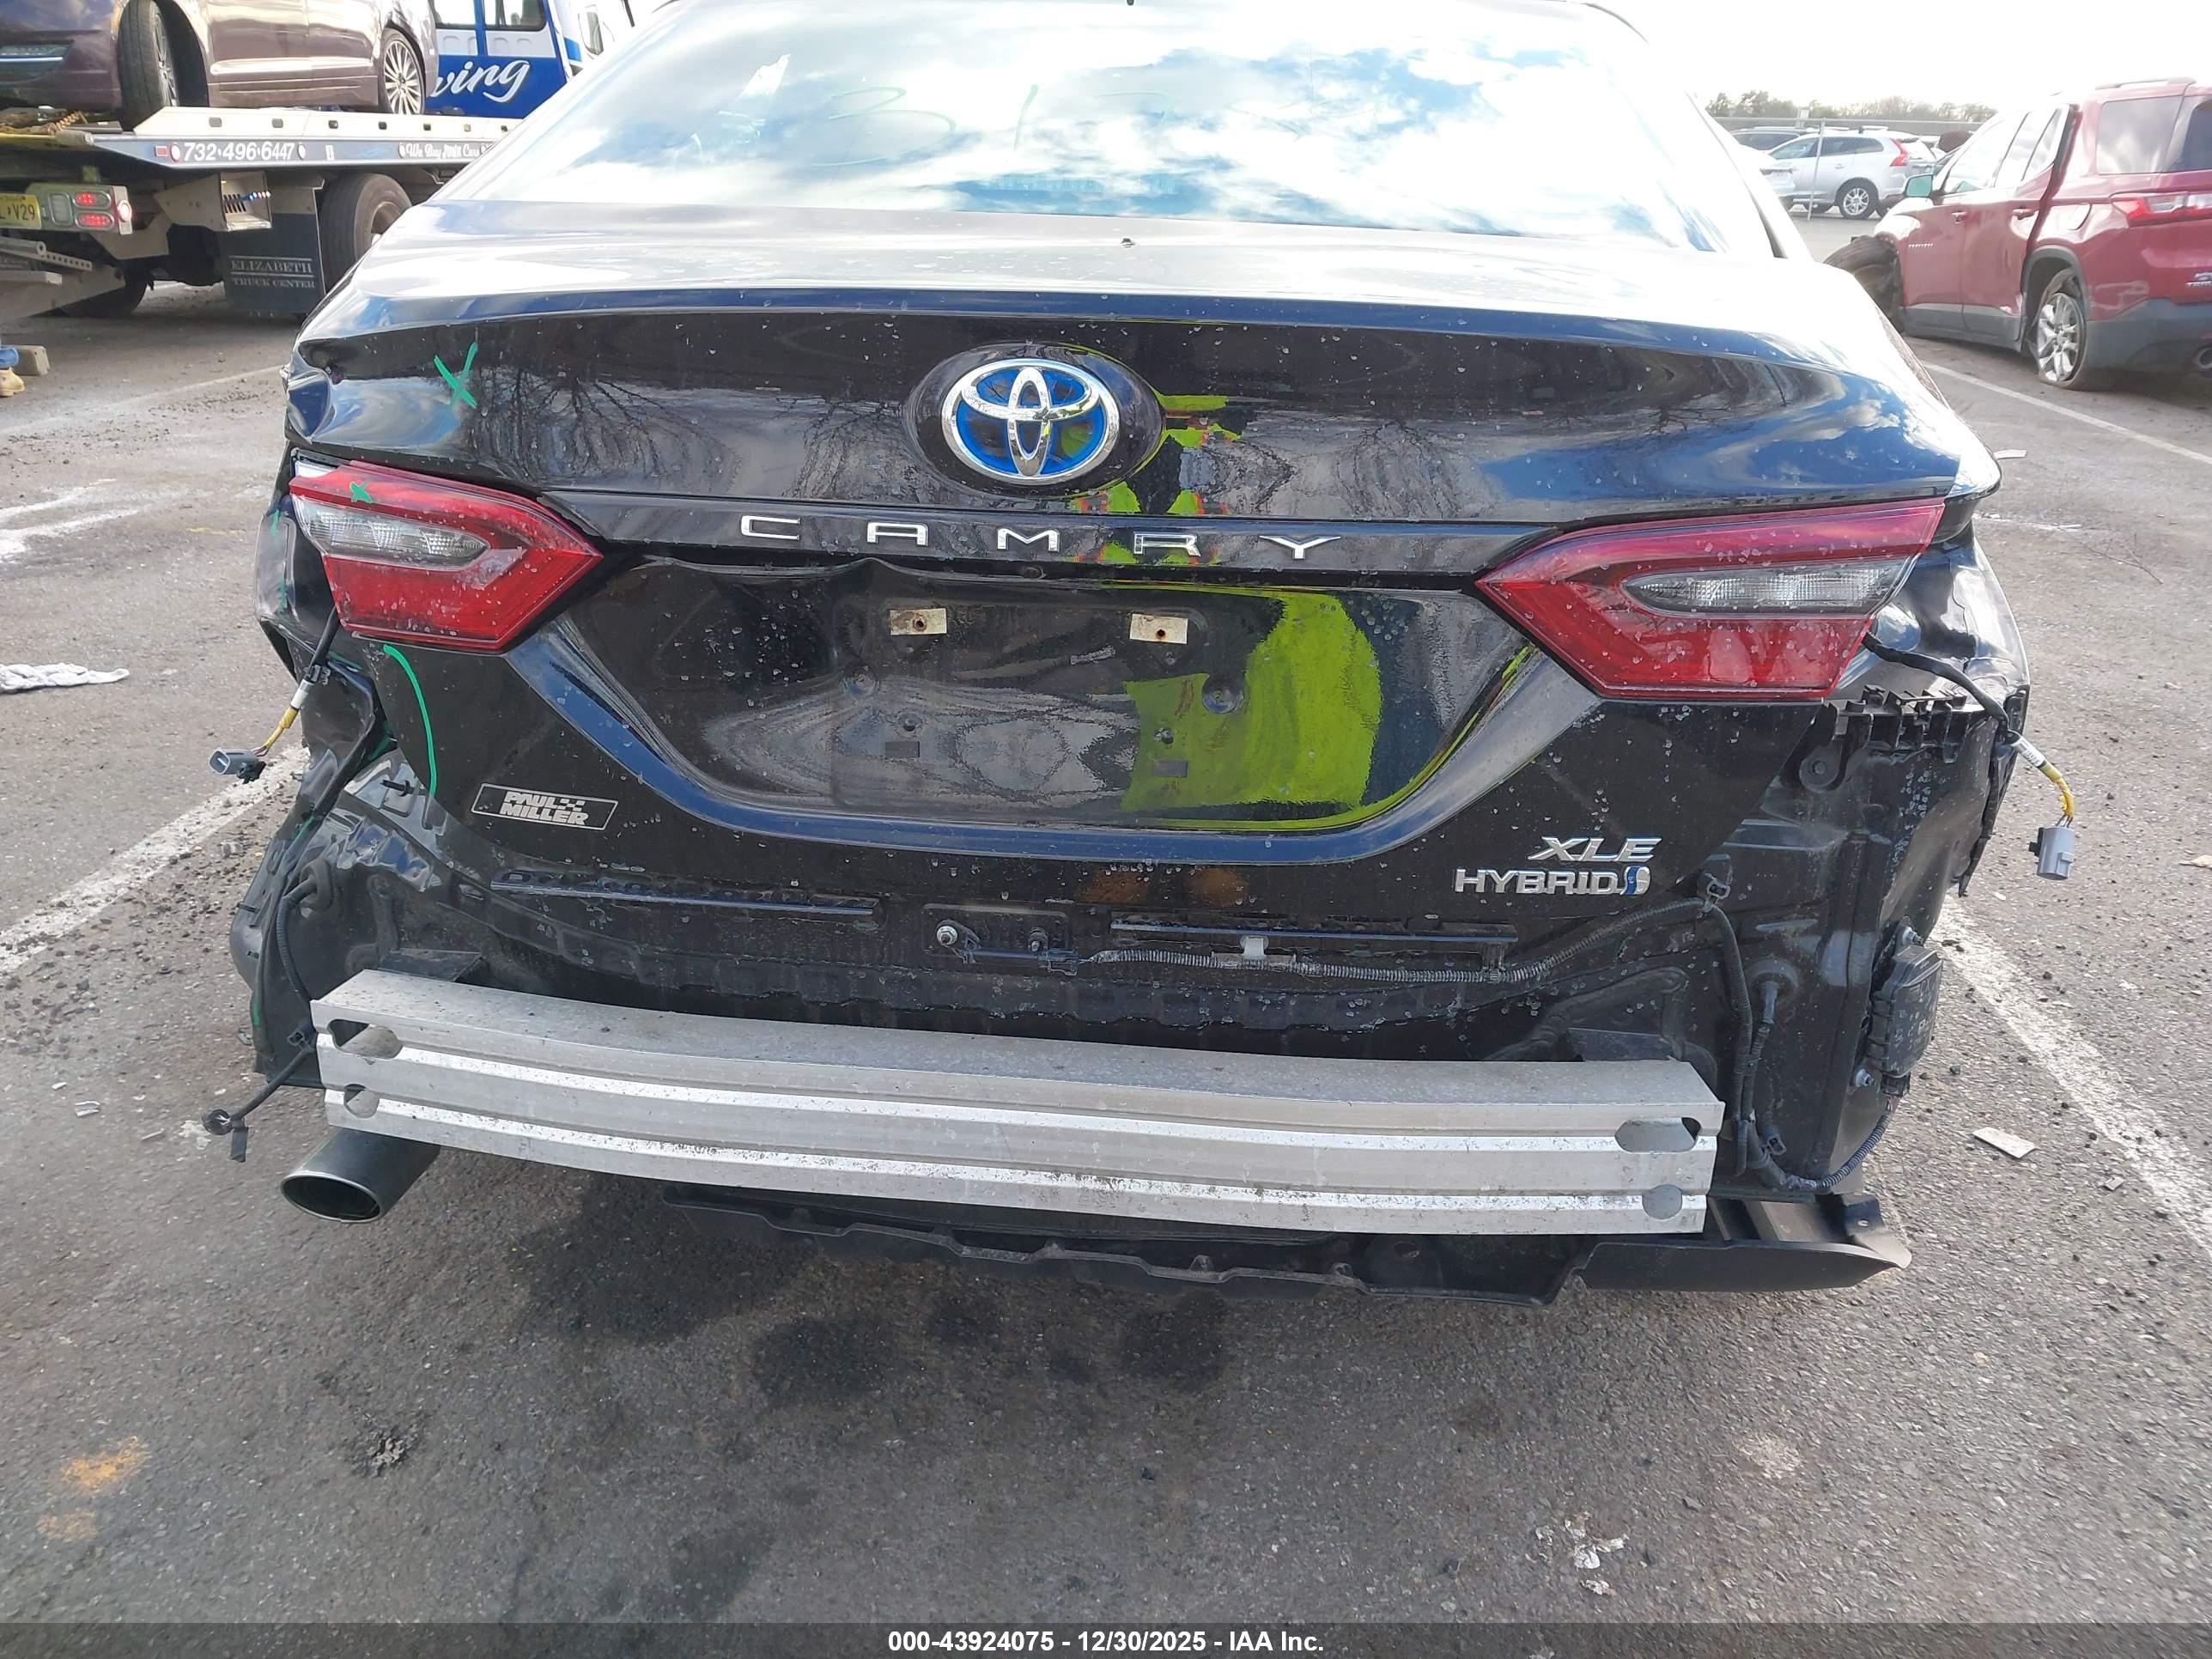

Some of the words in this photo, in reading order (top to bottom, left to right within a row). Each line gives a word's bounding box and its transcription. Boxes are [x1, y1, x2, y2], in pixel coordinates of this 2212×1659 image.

[231, 260, 313, 273] ELIZABETH
[232, 277, 270, 286] TRUCK
[272, 279, 316, 289] CENTER
[740, 515, 1341, 559] CAMRY
[504, 791, 560, 809] PAUL
[500, 803, 589, 825] MILLER
[1528, 836, 1662, 862] XLE
[1455, 868, 1621, 895] HYBRID
